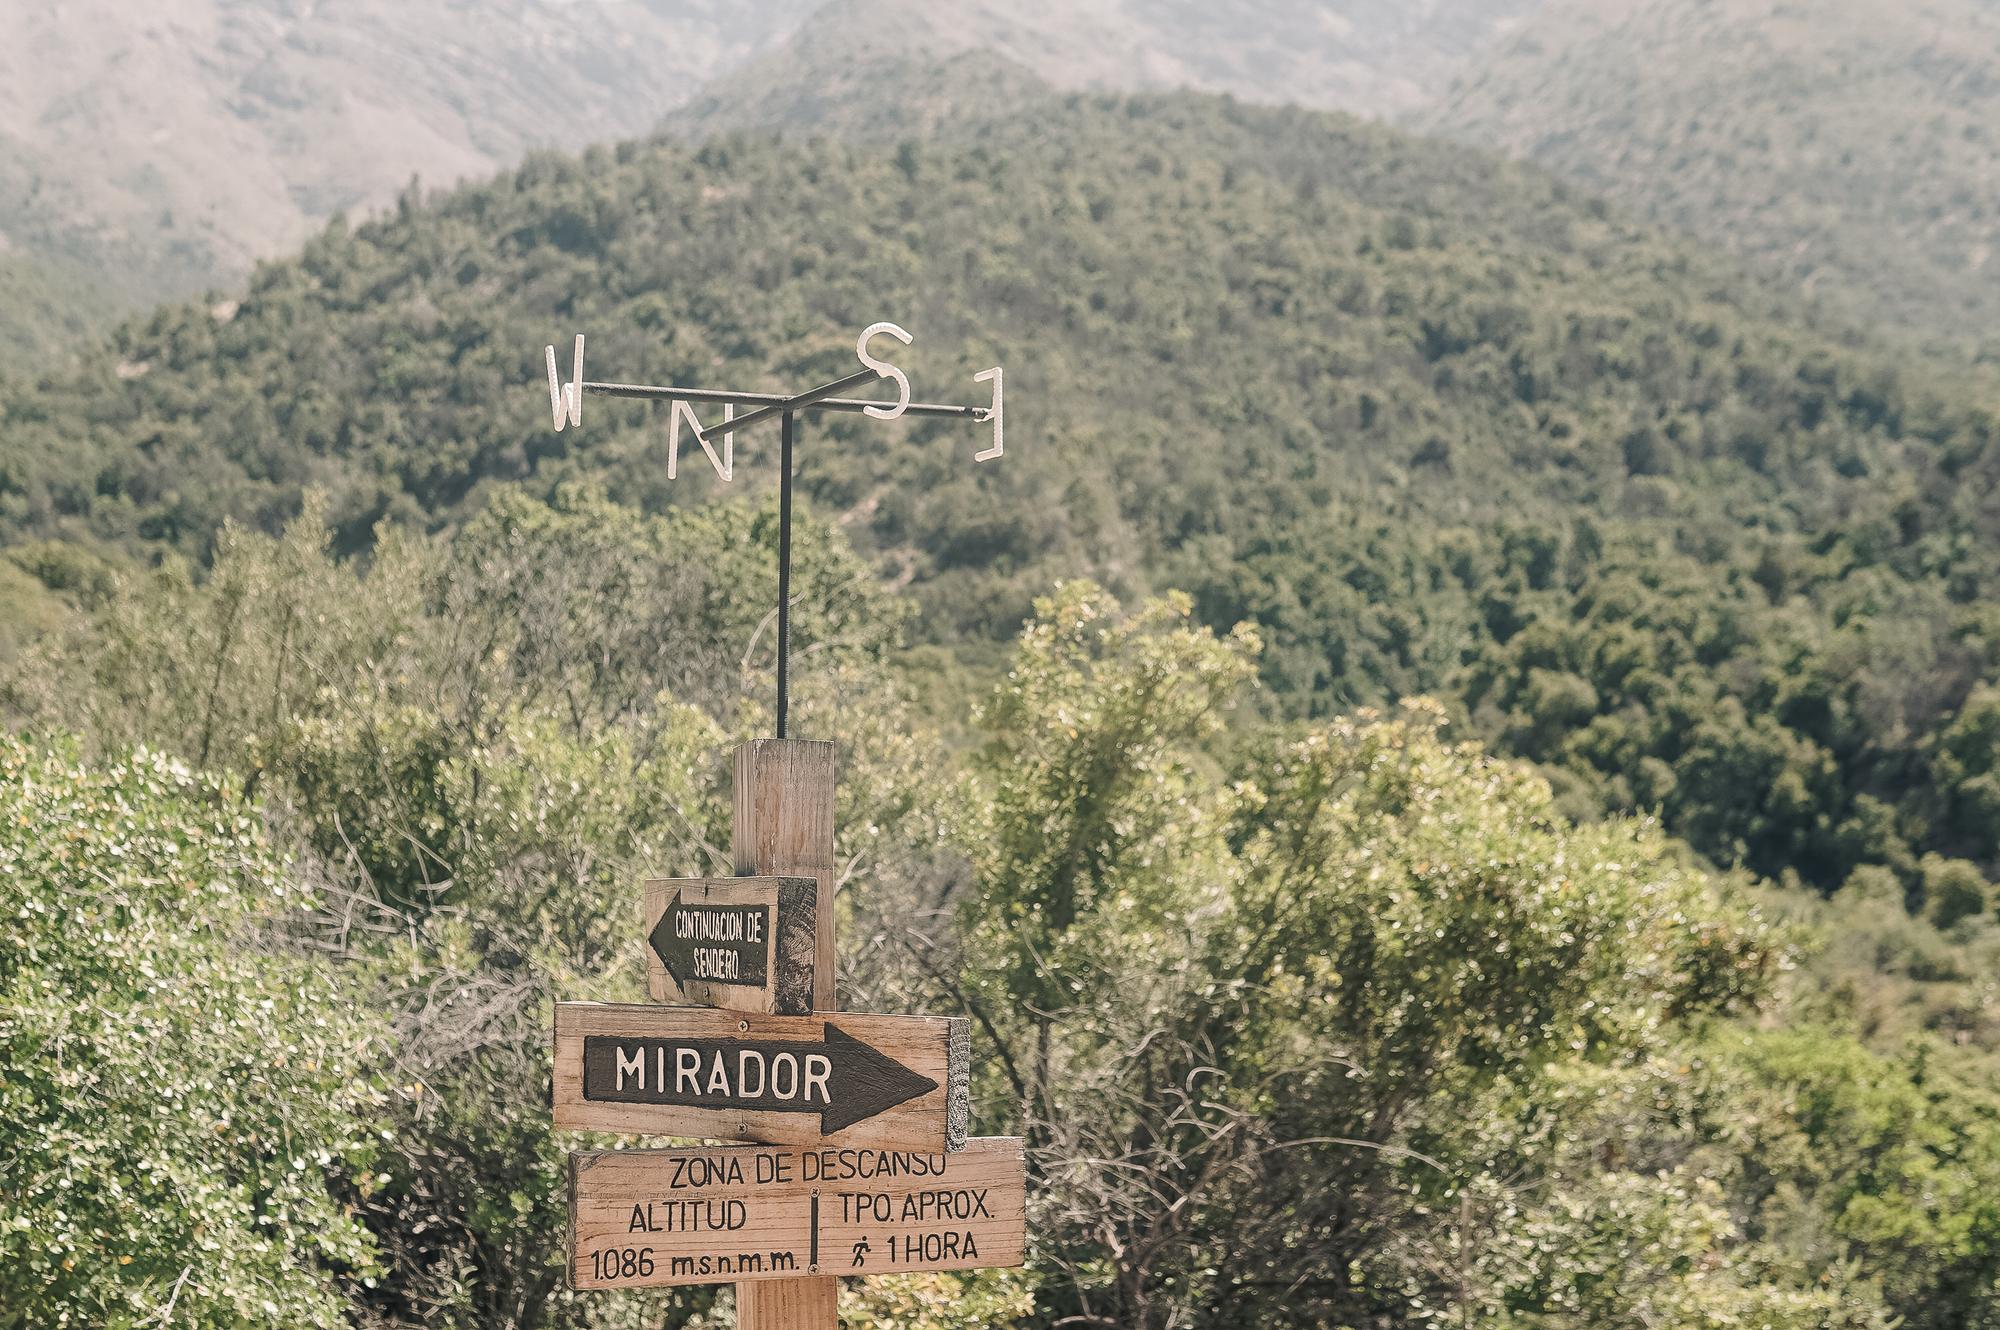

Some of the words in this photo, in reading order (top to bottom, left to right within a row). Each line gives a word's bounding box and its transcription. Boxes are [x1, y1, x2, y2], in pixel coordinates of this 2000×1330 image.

[544, 333, 585, 432] W
[856, 321, 914, 420] S
[667, 400, 733, 482] N
[675, 910, 743, 942] CONTINUACION
[747, 912, 762, 943] DE
[693, 948, 739, 979] SENDERO
[616, 1046, 832, 1103] MIRADOR
[669, 1157, 744, 1189] ZONA
[756, 1153, 793, 1184] DE
[629, 1200, 747, 1233] ALTITUD
[838, 1193, 895, 1223] TPO.
[901, 1189, 995, 1222] APROX.
[590, 1248, 655, 1280] 1.086
[671, 1251, 800, 1276] m.s.n.m.m.
[887, 1235, 896, 1263] 1
[905, 1231, 979, 1263] HORA
